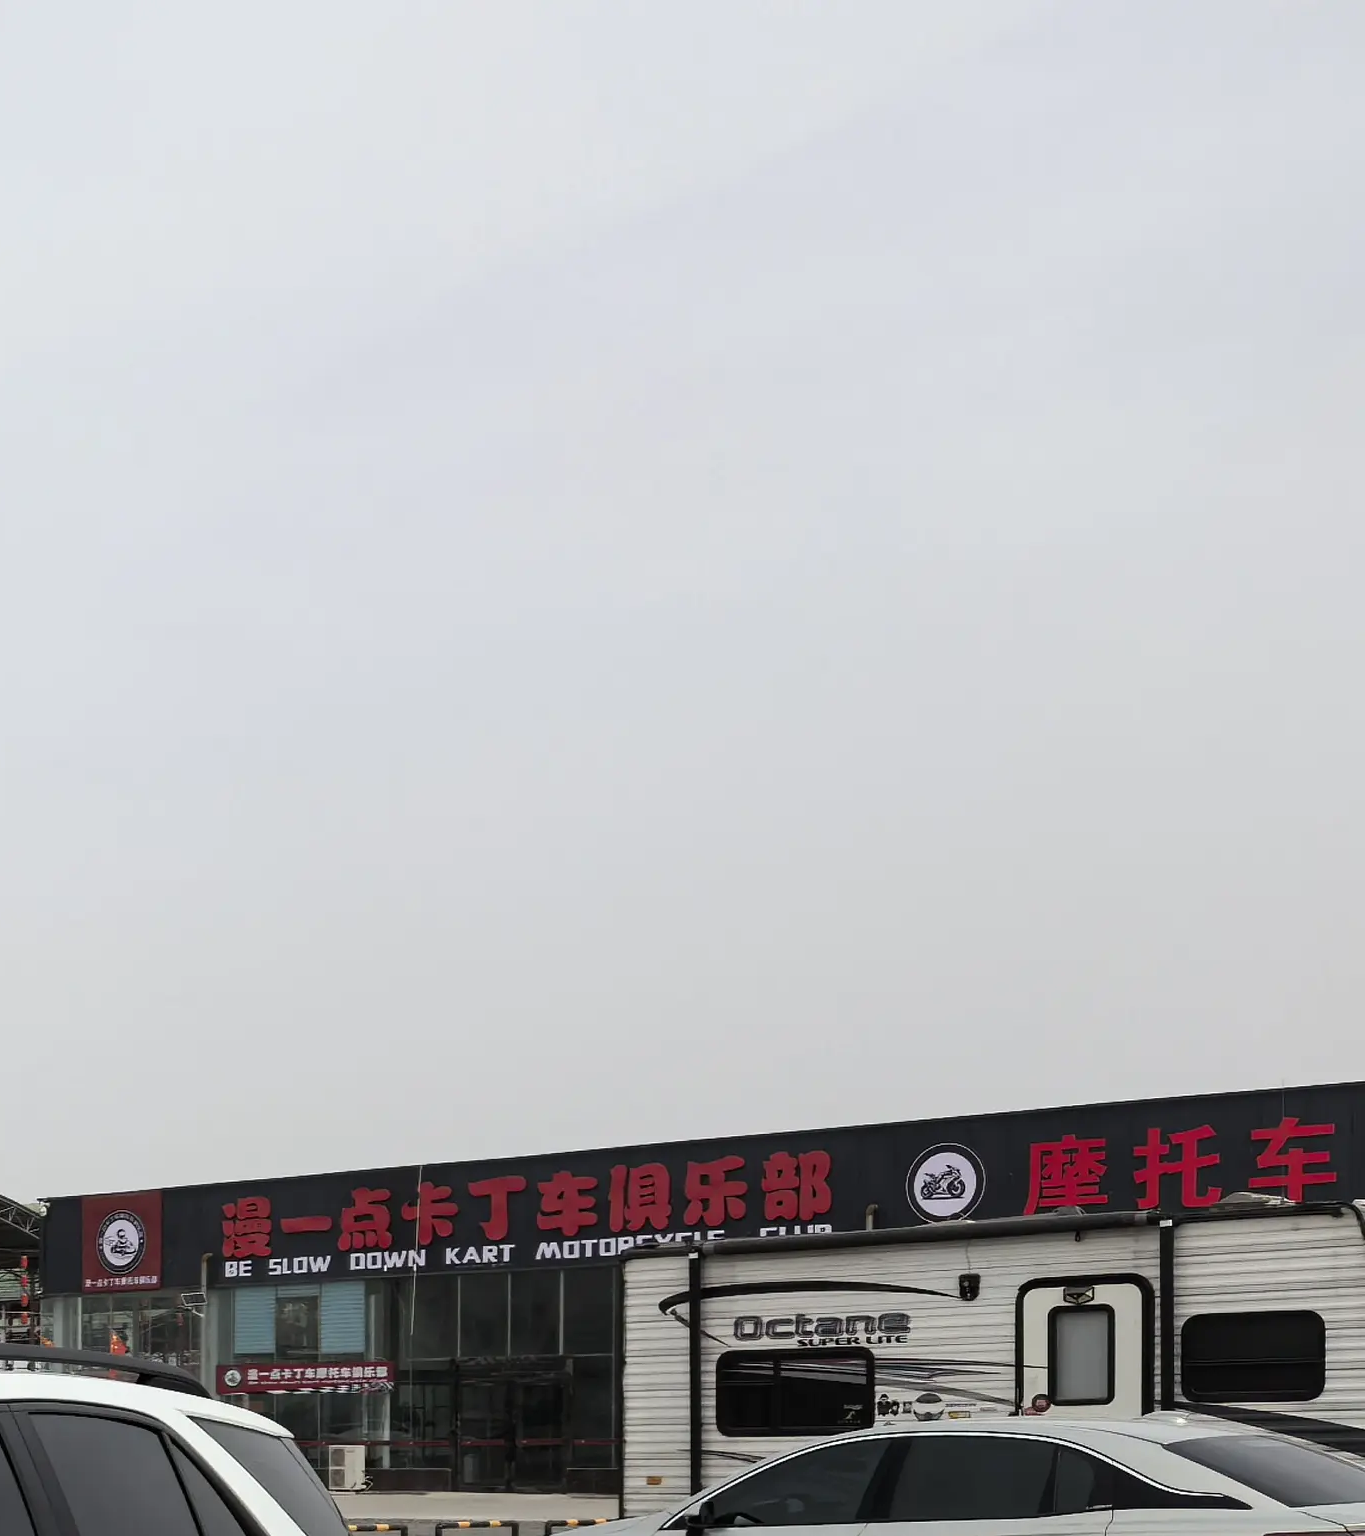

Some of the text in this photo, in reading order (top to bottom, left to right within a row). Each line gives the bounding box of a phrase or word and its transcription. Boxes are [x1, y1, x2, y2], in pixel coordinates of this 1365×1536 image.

[1023, 1117, 1337, 1216] 摩托车
[222, 1150, 832, 1258] 漫一点卡丁车俱乐部
[224, 1260, 252, 1277] BE
[268, 1256, 331, 1275] SLOW
[350, 1249, 426, 1271] DOWN
[445, 1244, 516, 1265] KART
[734, 1312, 911, 1341] Octane
[797, 1335, 908, 1347] SUPER LITE
